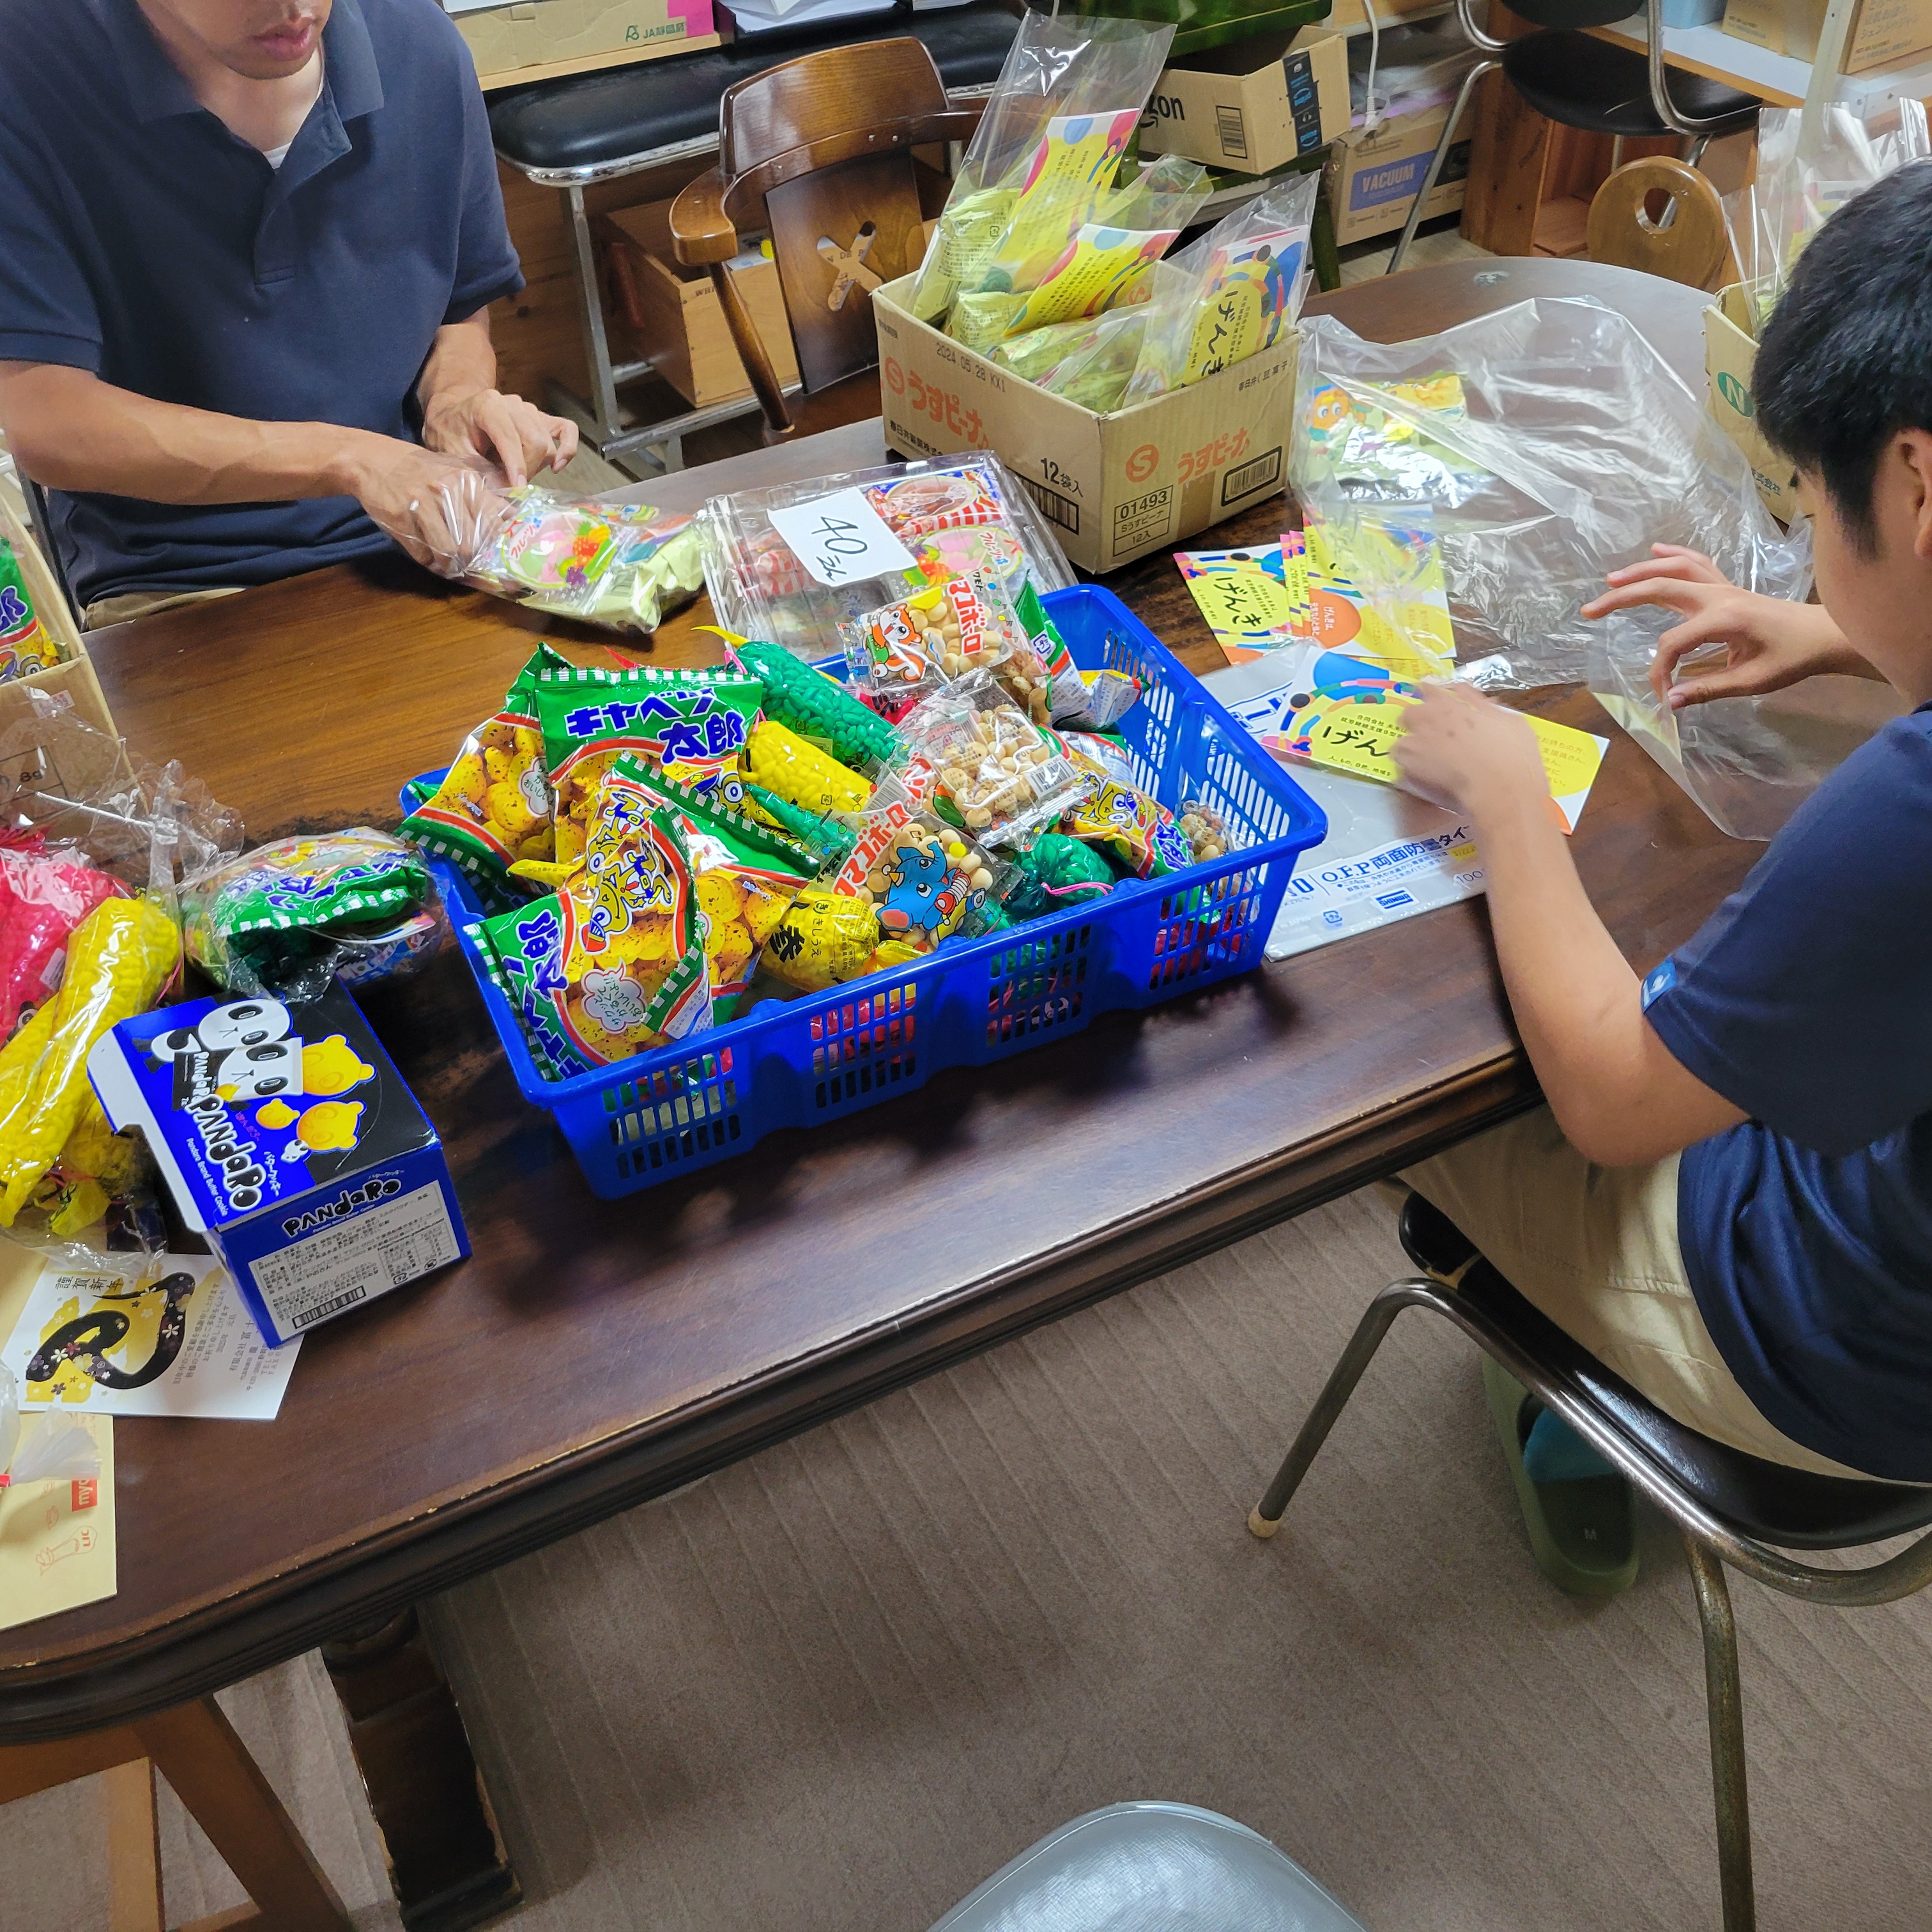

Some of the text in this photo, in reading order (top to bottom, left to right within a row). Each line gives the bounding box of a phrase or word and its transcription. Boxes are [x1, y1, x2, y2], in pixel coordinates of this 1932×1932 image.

[1362, 163, 1414, 193] VACUUM
[1201, 291, 1239, 377] げんき
[1177, 427, 1249, 484] うすピーナ
[1041, 457, 1084, 498] 12袋入
[1120, 489, 1168, 519] 01493
[1121, 509, 1165, 533] Sうすピーナ
[810, 515, 868, 555] 40
[1131, 530, 1151, 545] 12入
[1213, 577, 1262, 627] げんき
[564, 687, 716, 739] キャベツ
[1357, 714, 1384, 727] 合同会社
[657, 711, 747, 765] 太郎
[516, 908, 569, 1000] 太郎
[811, 918, 824, 959] きしうえ
[186, 1137, 228, 1216] Pandaro Brand Butter Cookie
[263, 1150, 281, 1197] バタークッキー
[54, 1276, 125, 1291] 謹賀新年
[1584, 1528, 1597, 1540] M
